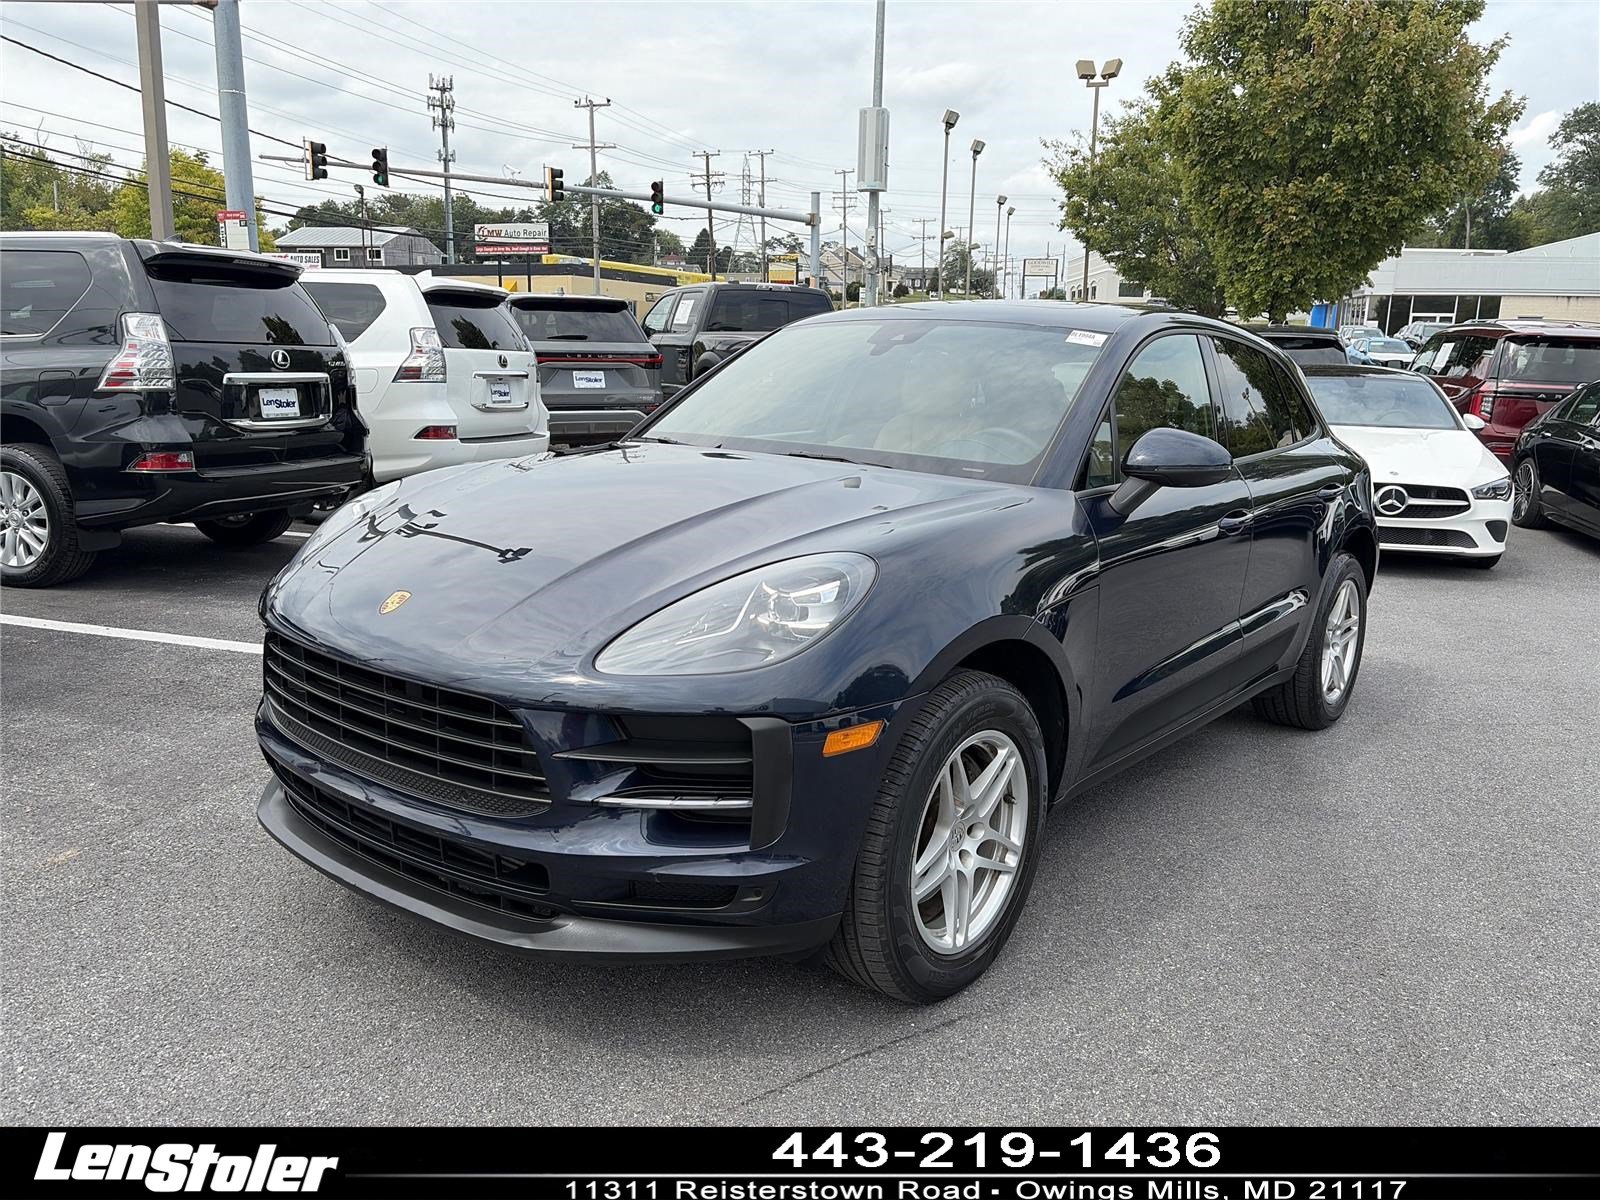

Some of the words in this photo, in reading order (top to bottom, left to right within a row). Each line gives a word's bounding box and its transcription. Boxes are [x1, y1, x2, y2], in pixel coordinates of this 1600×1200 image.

[504, 228, 521, 238] Auto
[522, 228, 547, 238] Repair
[304, 255, 320, 264] SALES
[262, 397, 297, 409] LenStoler
